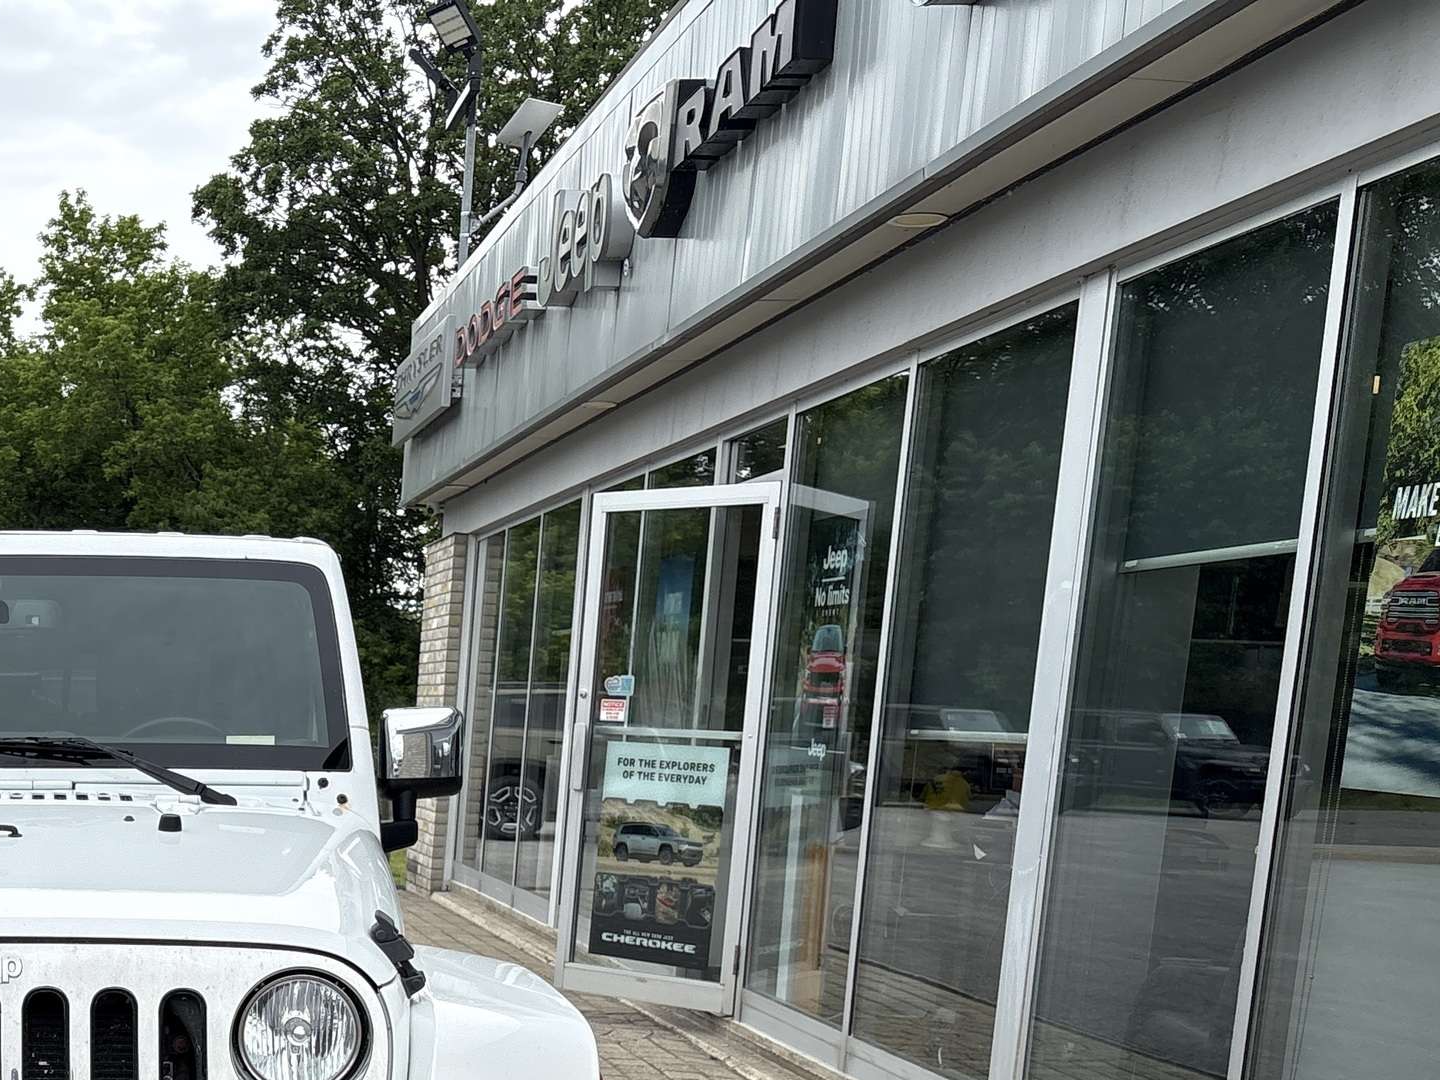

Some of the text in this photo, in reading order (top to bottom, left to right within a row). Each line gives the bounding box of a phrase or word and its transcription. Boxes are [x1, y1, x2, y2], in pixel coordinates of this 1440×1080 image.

[672, 0, 798, 171] RAM
[537, 173, 613, 307] Jeep
[454, 266, 530, 368] DODGE
[1392, 482, 1440, 521] MAKE
[823, 545, 848, 574] Jeep
[814, 584, 850, 607] No limits
[807, 738, 826, 761] Jeep
[617, 757, 716, 773] FOR THE EXPLORERS
[622, 770, 708, 785] OF THE EVERYDAY
[601, 932, 697, 954] CHEROKEE
